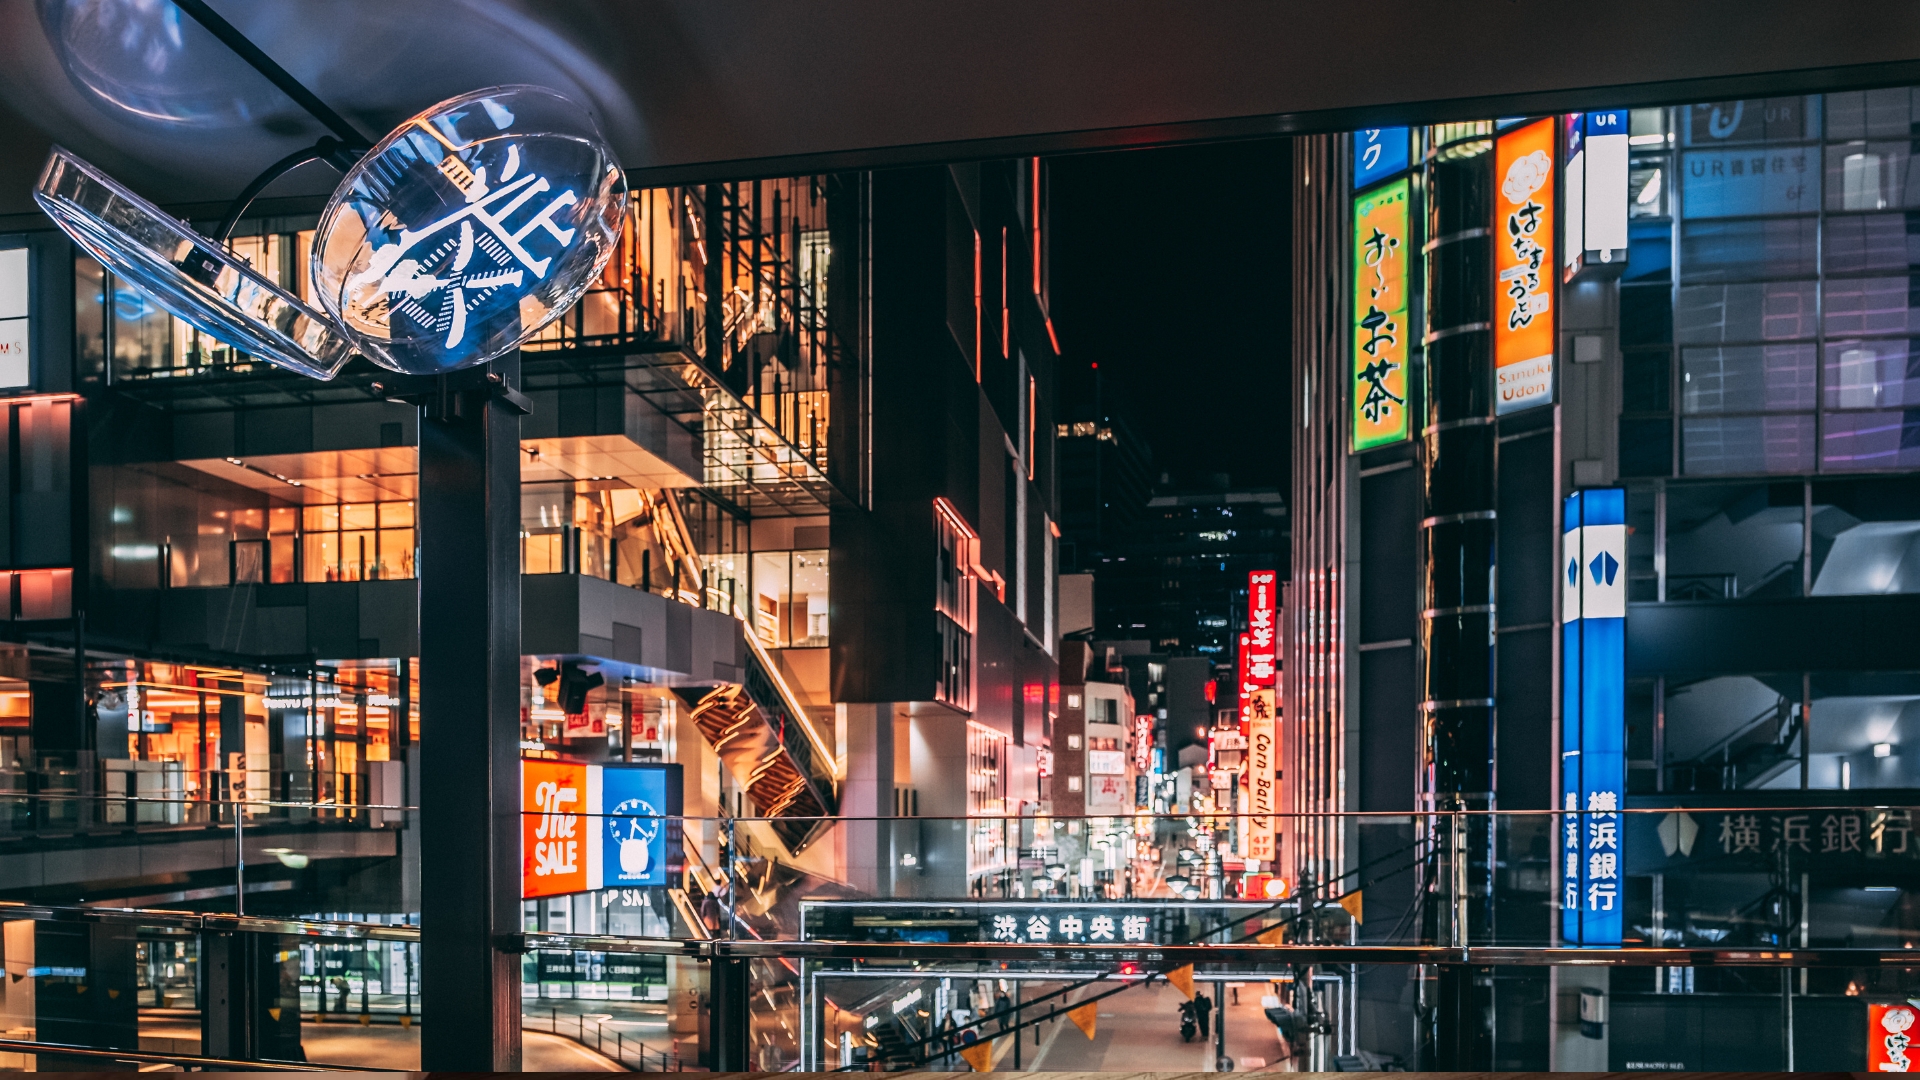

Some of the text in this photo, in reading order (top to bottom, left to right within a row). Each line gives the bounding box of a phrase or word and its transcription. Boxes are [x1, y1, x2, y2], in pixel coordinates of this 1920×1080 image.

[1596, 114, 1617, 126] UR
[1499, 363, 1551, 385] Sanuki
[1503, 383, 1546, 401] Udon
[535, 781, 577, 840] The
[1253, 836, 1270, 844] 4F
[1719, 813, 1913, 854] 横浜銀行
[535, 840, 578, 876] SALE
[1253, 847, 1270, 856] 3F
[1588, 791, 1617, 911] 横浜銀行
[993, 914, 1147, 941] 渋谷中央街
